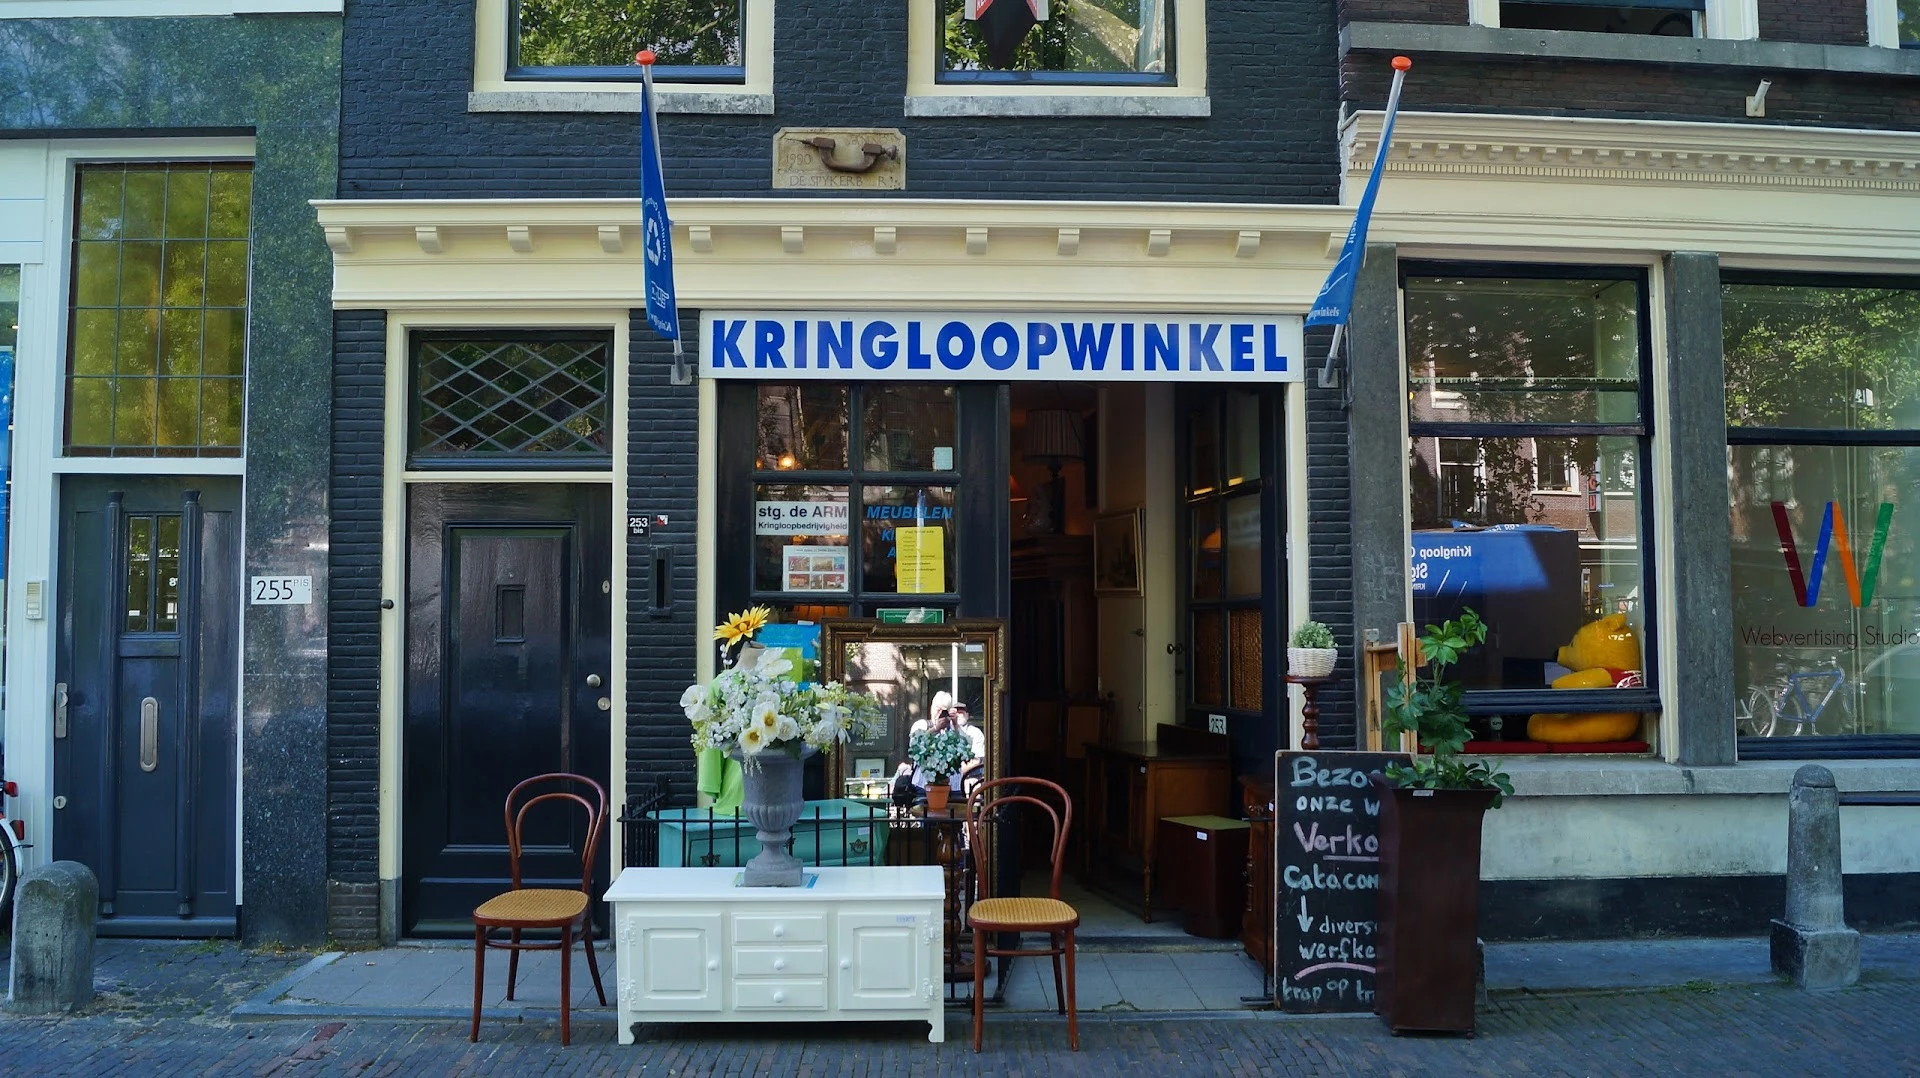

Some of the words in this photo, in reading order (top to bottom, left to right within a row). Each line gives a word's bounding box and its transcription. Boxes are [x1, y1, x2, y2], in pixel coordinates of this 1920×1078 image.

[789, 175, 805, 187] DE
[712, 319, 1288, 372] KRINGLOOPWINKEL
[629, 517, 649, 528] 253
[758, 505, 786, 520] stg.
[789, 505, 808, 517] de
[812, 505, 848, 518] ARM
[866, 506, 953, 519] MEUBELEN
[758, 521, 848, 531] Kringloopbedrijvigheid
[256, 580, 293, 600] 255
[1741, 625, 1859, 650] Webvertising
[1864, 625, 1919, 646] Studio
[1290, 756, 1382, 788] Bezo
[1293, 821, 1379, 855] Verko
[1319, 914, 1378, 935] divers
[1282, 976, 1322, 1002] trap
[1326, 978, 1349, 999] op
[1356, 979, 1376, 1002] tr
